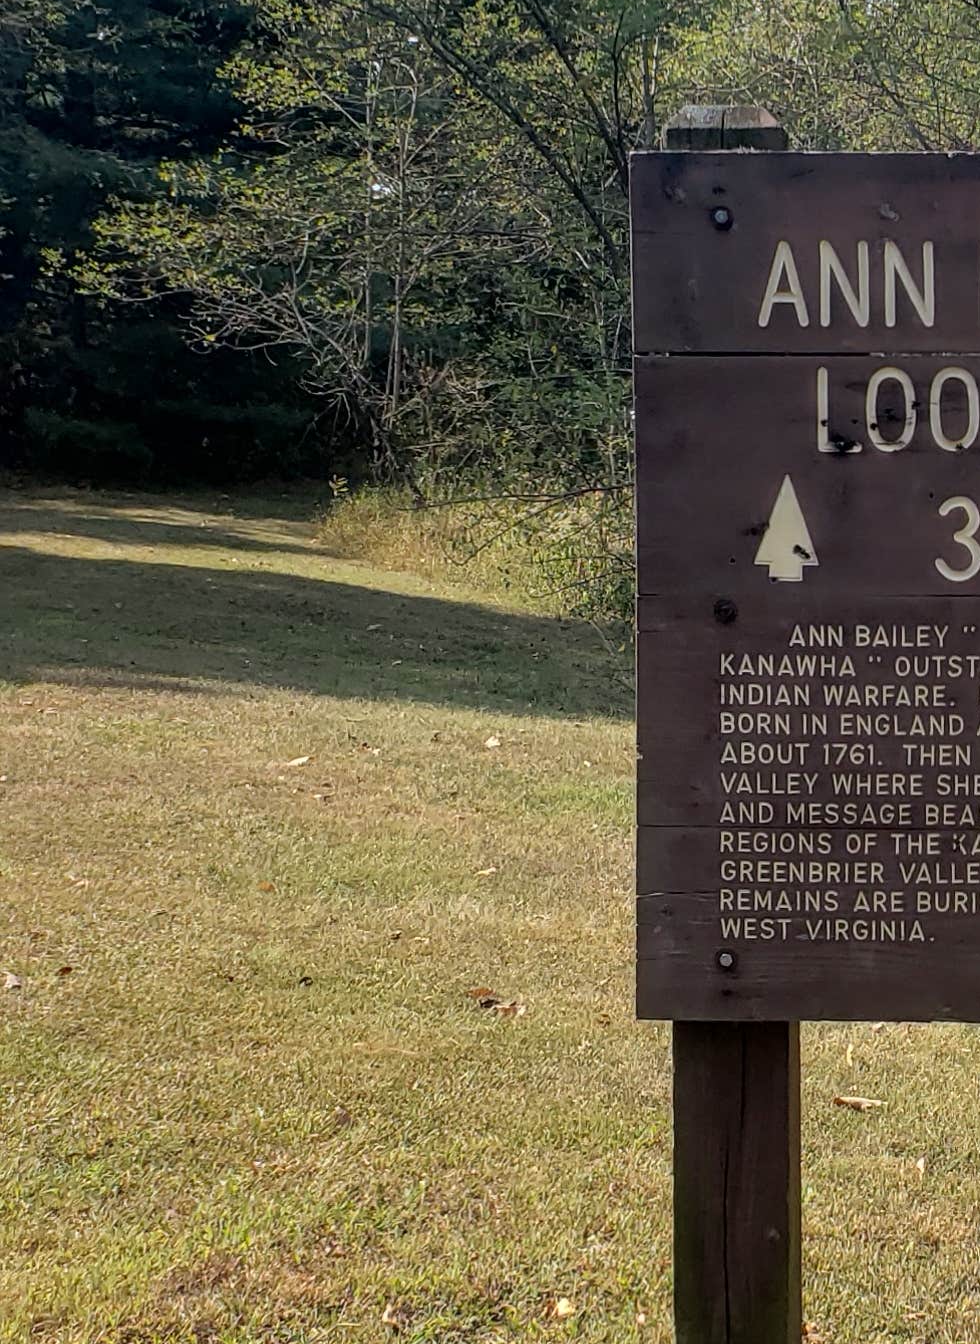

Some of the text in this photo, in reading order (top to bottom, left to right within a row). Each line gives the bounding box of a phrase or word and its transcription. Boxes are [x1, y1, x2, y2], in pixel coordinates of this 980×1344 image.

[758, 240, 935, 328] ANN
[789, 624, 843, 647] ANN
[855, 625, 949, 648] BAILEY
[720, 654, 856, 677] KANAWHA
[720, 684, 809, 706] INDIAN
[823, 685, 956, 706] WARFARE.
[720, 712, 790, 735] BORN
[803, 714, 827, 735] IN
[840, 714, 964, 736] ENGLAND
[720, 742, 809, 765] ABOUT
[823, 744, 883, 765] 1761.
[903, 744, 970, 766] THEN
[721, 772, 818, 794] VALLEY
[832, 774, 923, 795] WHERE
[719, 802, 774, 824] AND
[787, 803, 911, 825] MESSAGE
[720, 832, 831, 854] REGIONS
[846, 833, 878, 854] OF
[891, 833, 940, 855] THE
[721, 861, 884, 884] GREENBRIER
[720, 890, 838, 912] REMAINS
[853, 891, 904, 912] ARE
[721, 918, 934, 942] WEST VIRGINIA.
